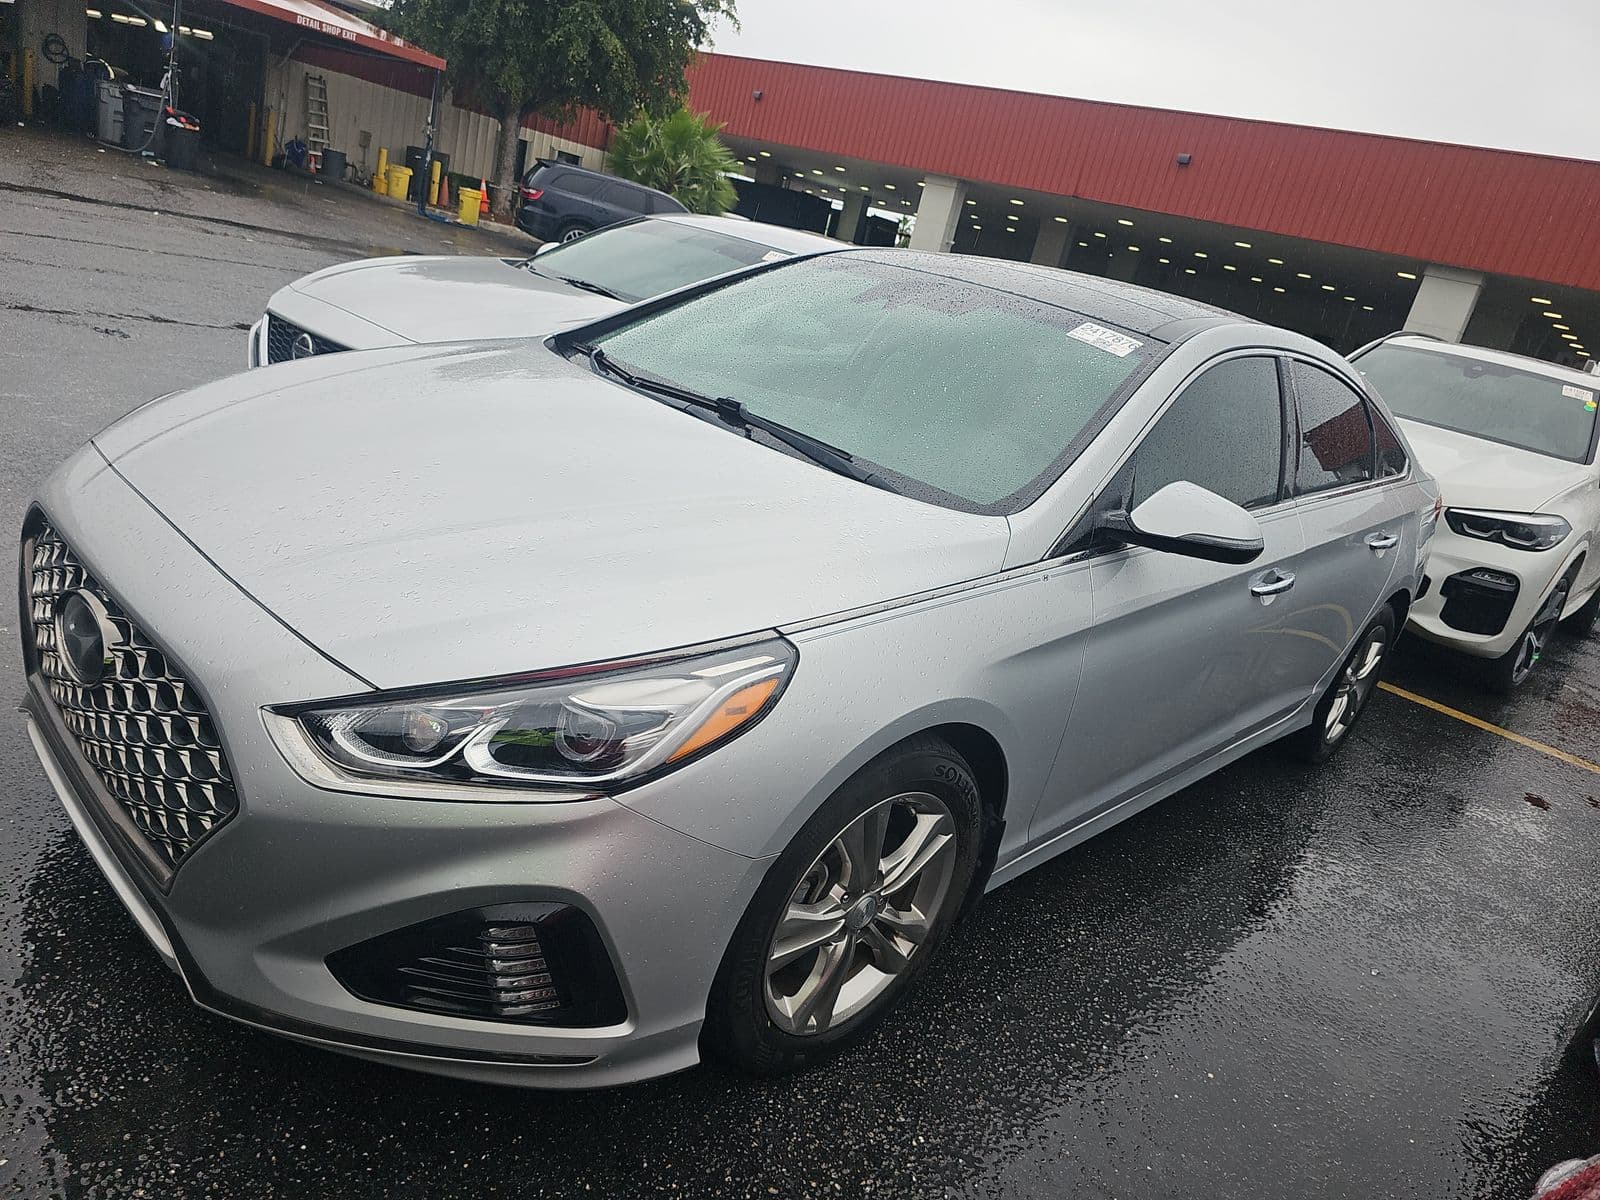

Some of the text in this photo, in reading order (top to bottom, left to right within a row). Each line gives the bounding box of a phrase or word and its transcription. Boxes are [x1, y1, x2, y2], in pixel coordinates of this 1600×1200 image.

[297, 15, 357, 41] DETAIL SHOP EXIT
